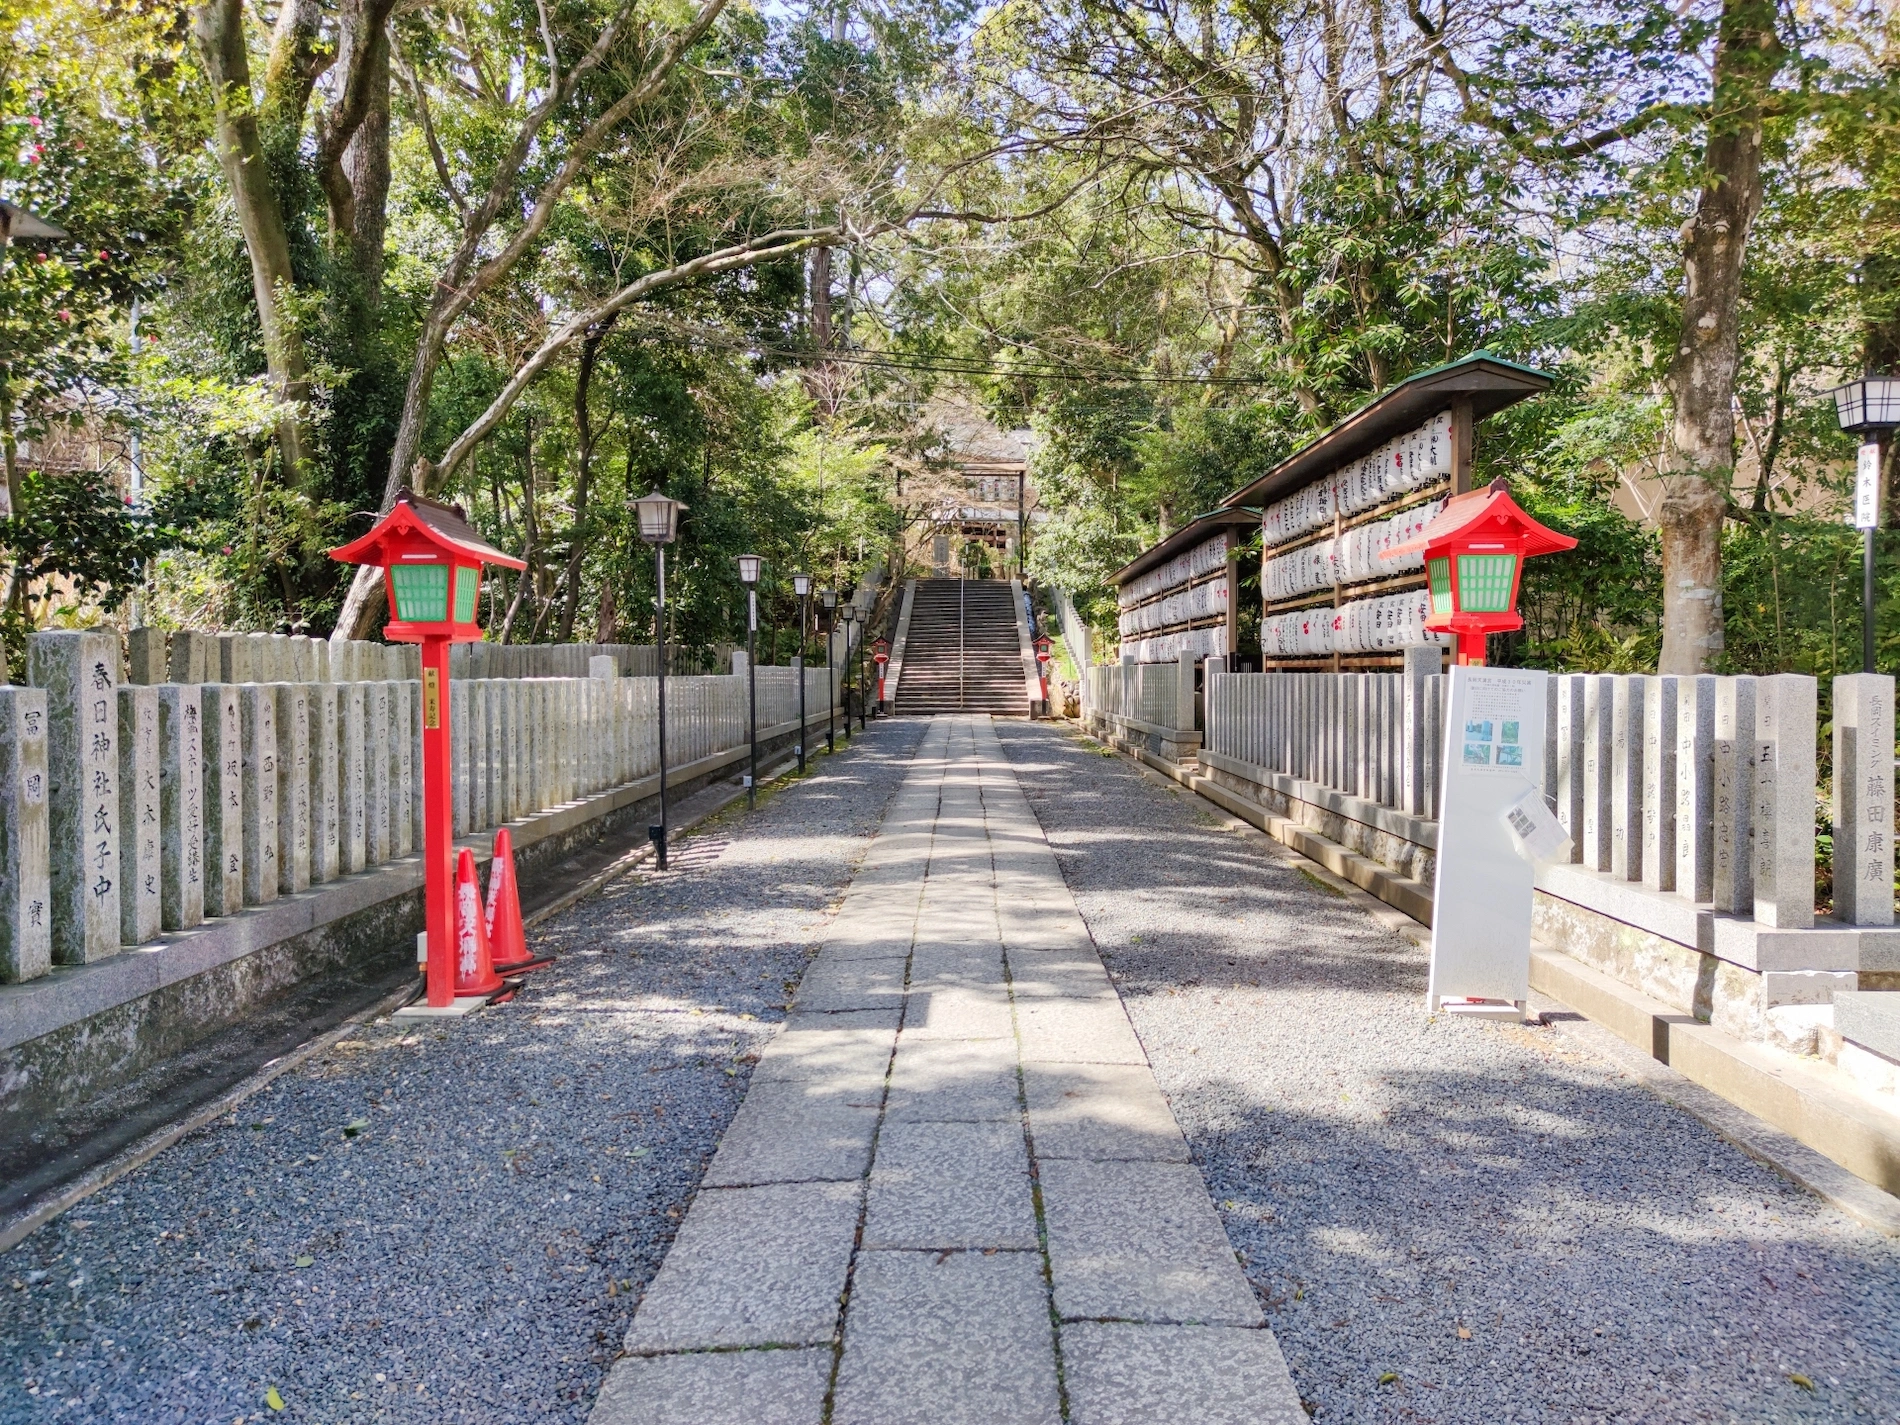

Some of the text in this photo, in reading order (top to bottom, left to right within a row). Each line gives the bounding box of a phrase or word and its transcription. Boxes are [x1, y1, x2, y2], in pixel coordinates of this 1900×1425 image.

[1861, 460, 1872, 522] 鈴木医院
[90, 660, 112, 908] 春日神社氏子中
